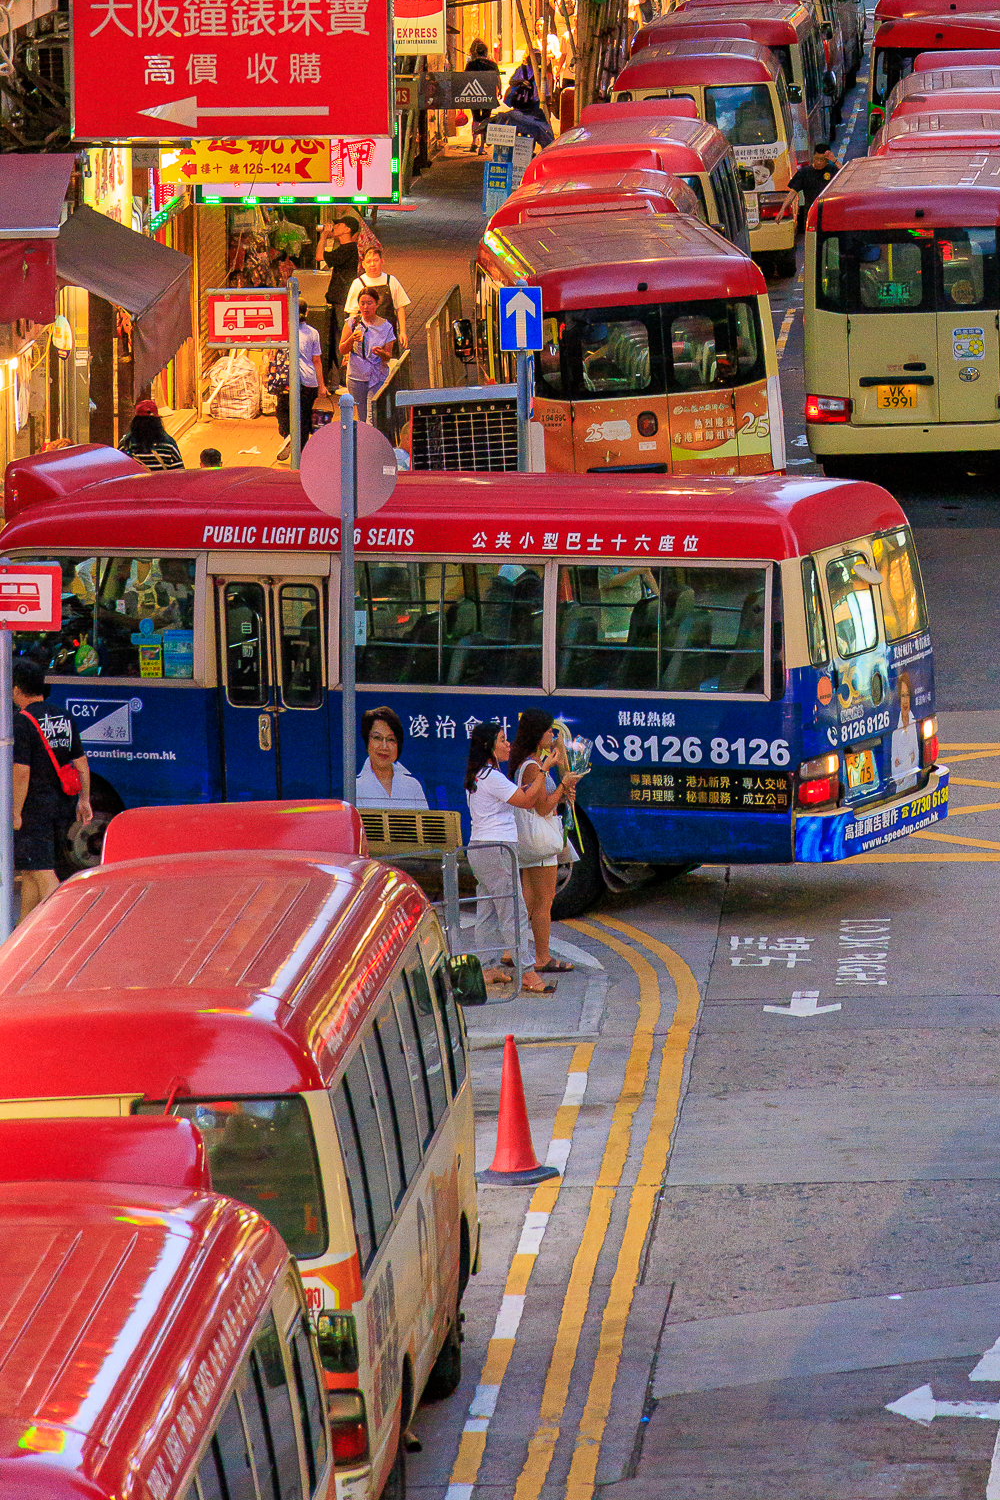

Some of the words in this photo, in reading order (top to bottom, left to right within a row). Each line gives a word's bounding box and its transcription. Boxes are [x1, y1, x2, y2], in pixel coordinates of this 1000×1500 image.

[396, 27, 438, 39] EXPRESS
[143, 52, 218, 86] 高價
[246, 52, 323, 85] 收購
[242, 162, 291, 174] 126-124
[882, 396, 914, 408] 3991
[889, 386, 906, 397] VK
[737, 411, 770, 438] 25
[202, 525, 257, 544] PUBLIC
[261, 526, 306, 545] LIGHT
[308, 527, 340, 545] BUS
[366, 528, 415, 547] SEATS
[472, 531, 700, 553] 公共小型巴士十六座位
[71, 704, 100, 717] C&Y
[617, 710, 676, 727] 報稅熱線
[841, 721, 866, 742] 8126
[866, 711, 890, 733] 8126
[623, 735, 702, 763] 8126
[710, 737, 790, 767] 8126
[911, 797, 931, 817] 2730
[862, 812, 939, 850] www.speedup.com.hk
